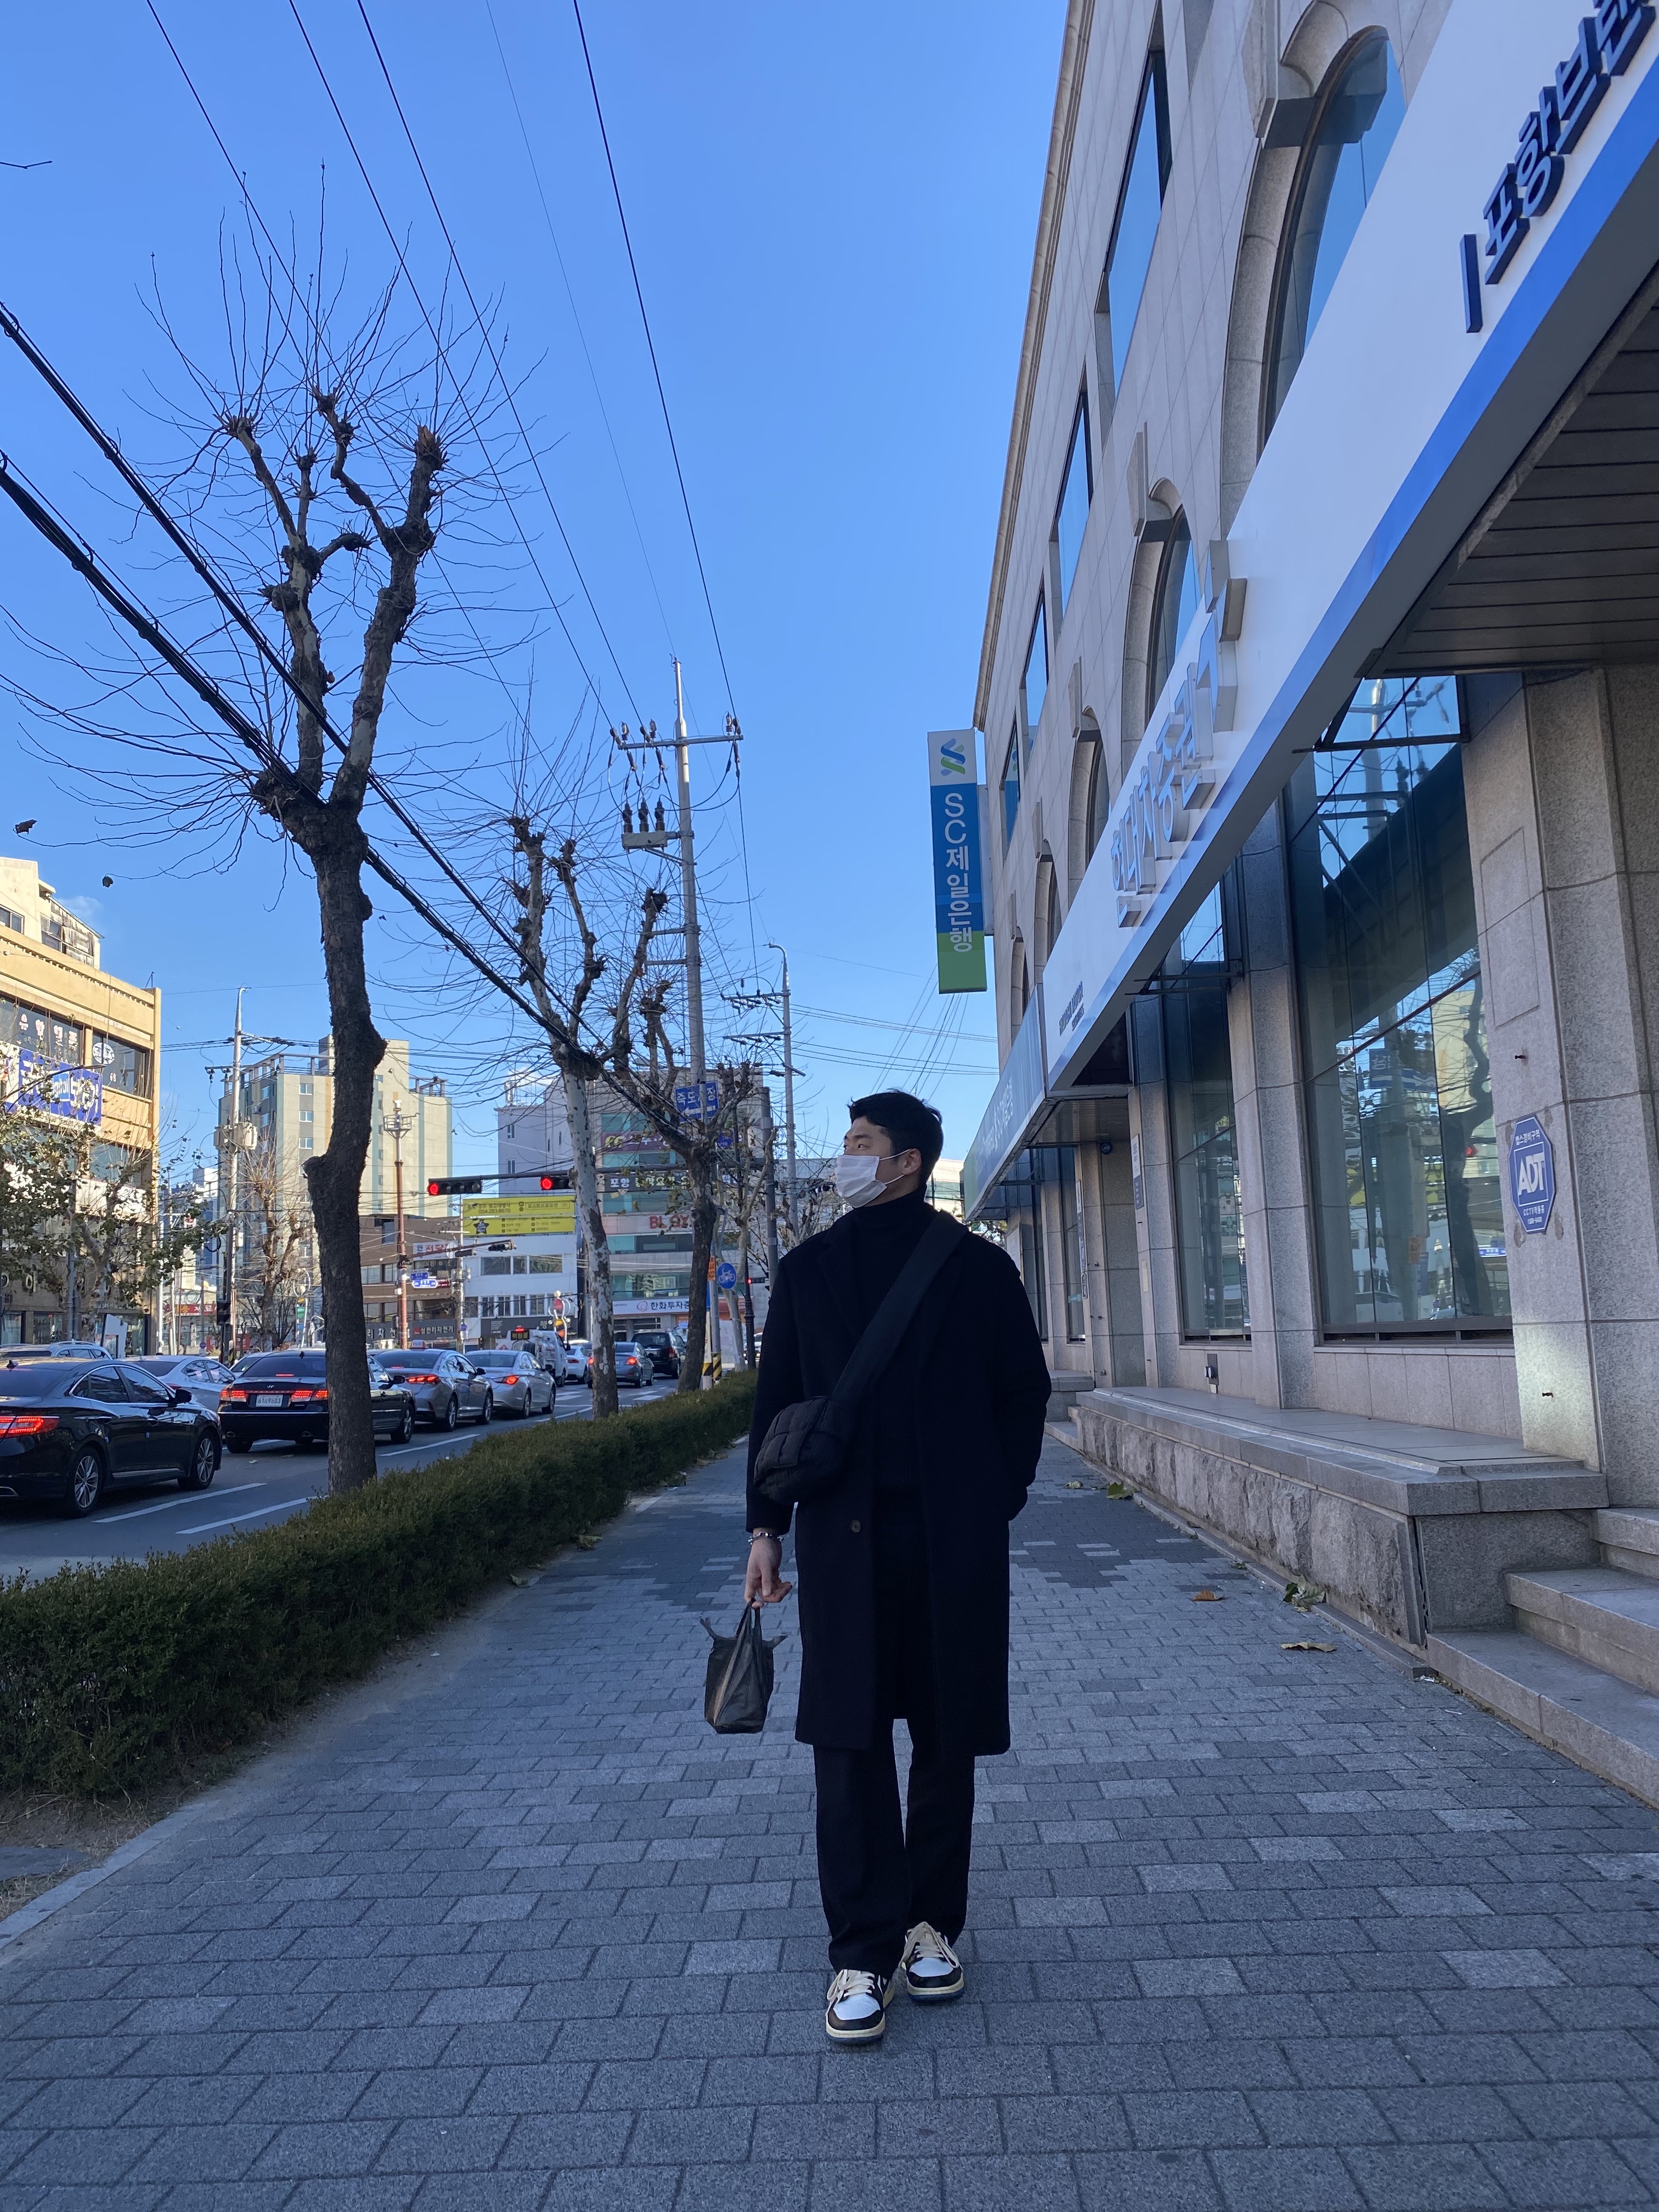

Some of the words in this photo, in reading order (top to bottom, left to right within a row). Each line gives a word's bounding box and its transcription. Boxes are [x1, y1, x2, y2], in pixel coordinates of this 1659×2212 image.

[1110, 662, 1211, 927] 현대차증권
[944, 793, 973, 952] SC제일은행
[676, 1086, 716, 1106] 죽도장
[1518, 1152, 1545, 1196] ADT
